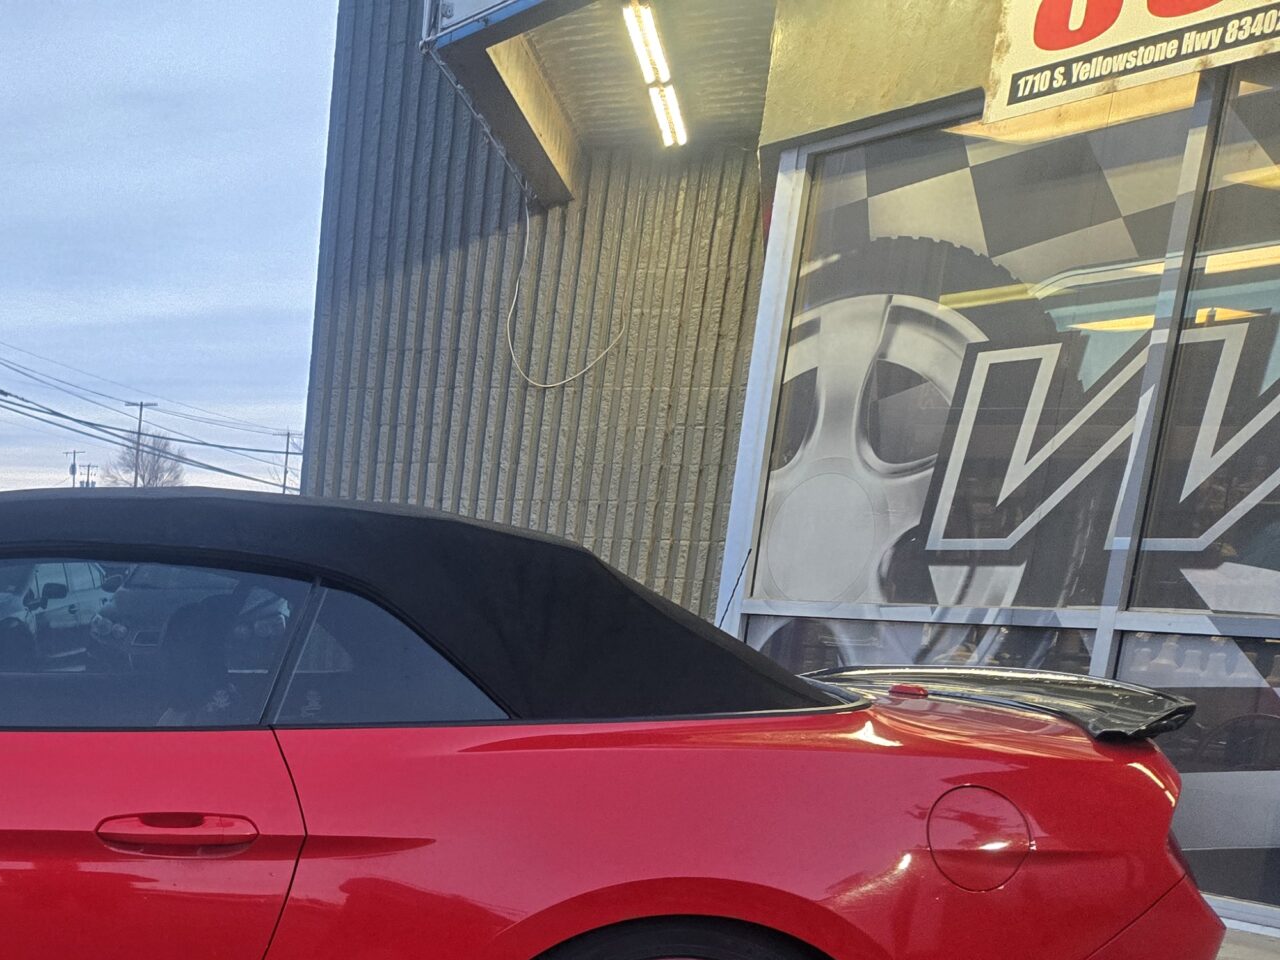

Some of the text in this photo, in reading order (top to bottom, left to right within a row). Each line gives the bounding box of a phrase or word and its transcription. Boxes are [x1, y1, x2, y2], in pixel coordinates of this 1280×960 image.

[1016, 67, 1050, 98] 1710
[1052, 62, 1067, 87] S.
[1071, 36, 1178, 84] Yellowstone
[1181, 26, 1224, 55] Hwy
